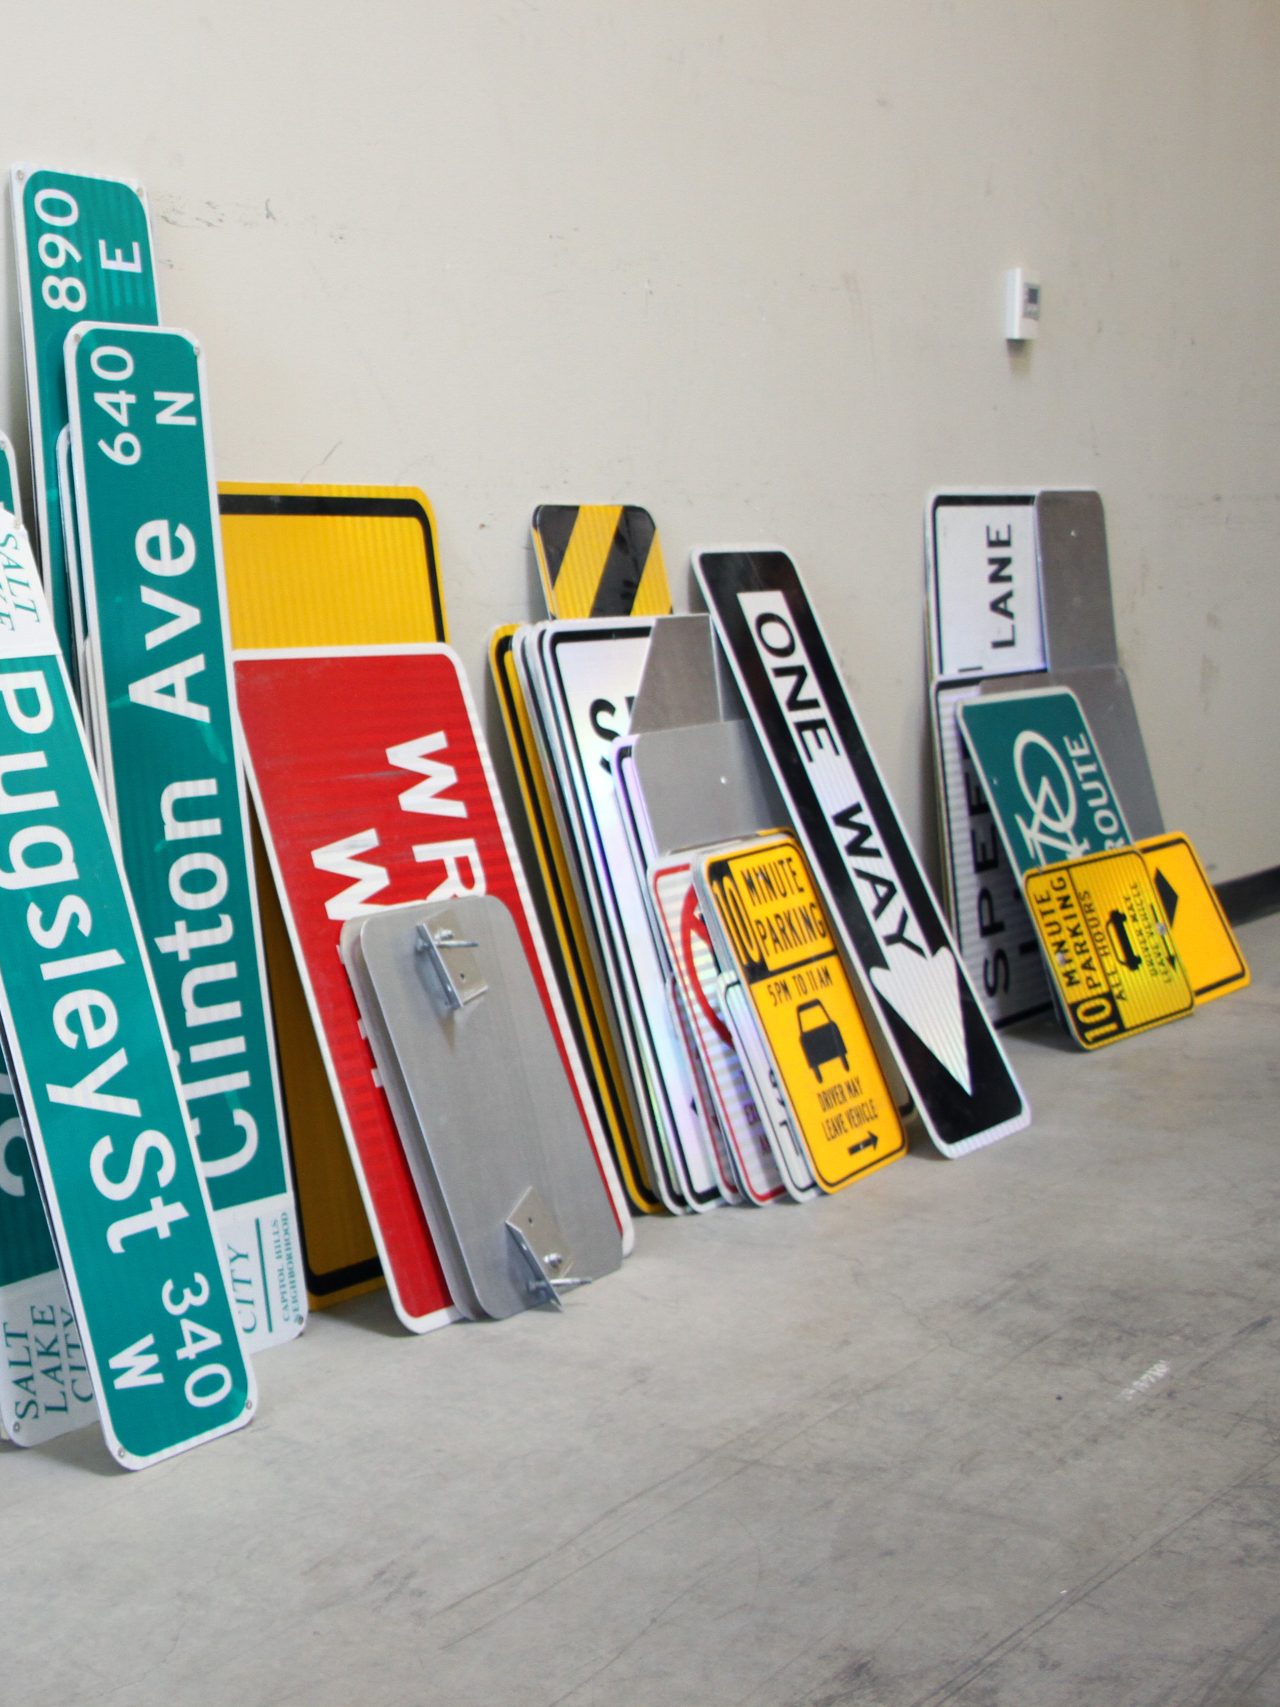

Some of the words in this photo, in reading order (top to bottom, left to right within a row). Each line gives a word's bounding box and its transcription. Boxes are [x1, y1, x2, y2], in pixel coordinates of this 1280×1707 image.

[34, 188, 87, 312] 890
[99, 239, 142, 273] E
[90, 346, 141, 466] 640
[153, 391, 197, 425] N
[128, 518, 211, 725] Ave
[986, 523, 1016, 649] LANE
[755, 612, 840, 763] ONE
[831, 802, 927, 959] WAY
[740, 857, 805, 907] MINUTE
[960, 733, 1010, 997] SPEE
[711, 875, 762, 966] 10
[754, 901, 827, 957] PARKING
[1033, 889, 1081, 988] MINUTE
[1050, 875, 1102, 991] PARKING
[1077, 890, 1111, 958] HOURS
[154, 777, 259, 1178] Clinton
[792, 974, 808, 997] TO
[1076, 997, 1118, 1042] 10
[845, 1098, 878, 1129] VEHICLE
[90, 1129, 190, 1254] St
[272, 1220, 282, 1260] HILLS
[227, 1244, 257, 1334] CITY
[277, 1268, 290, 1322] CAPITOL
[3, 1322, 39, 1420] SALT
[30, 1305, 68, 1414] LAKE
[108, 1333, 165, 1390] W
[161, 1272, 232, 1408] 340
